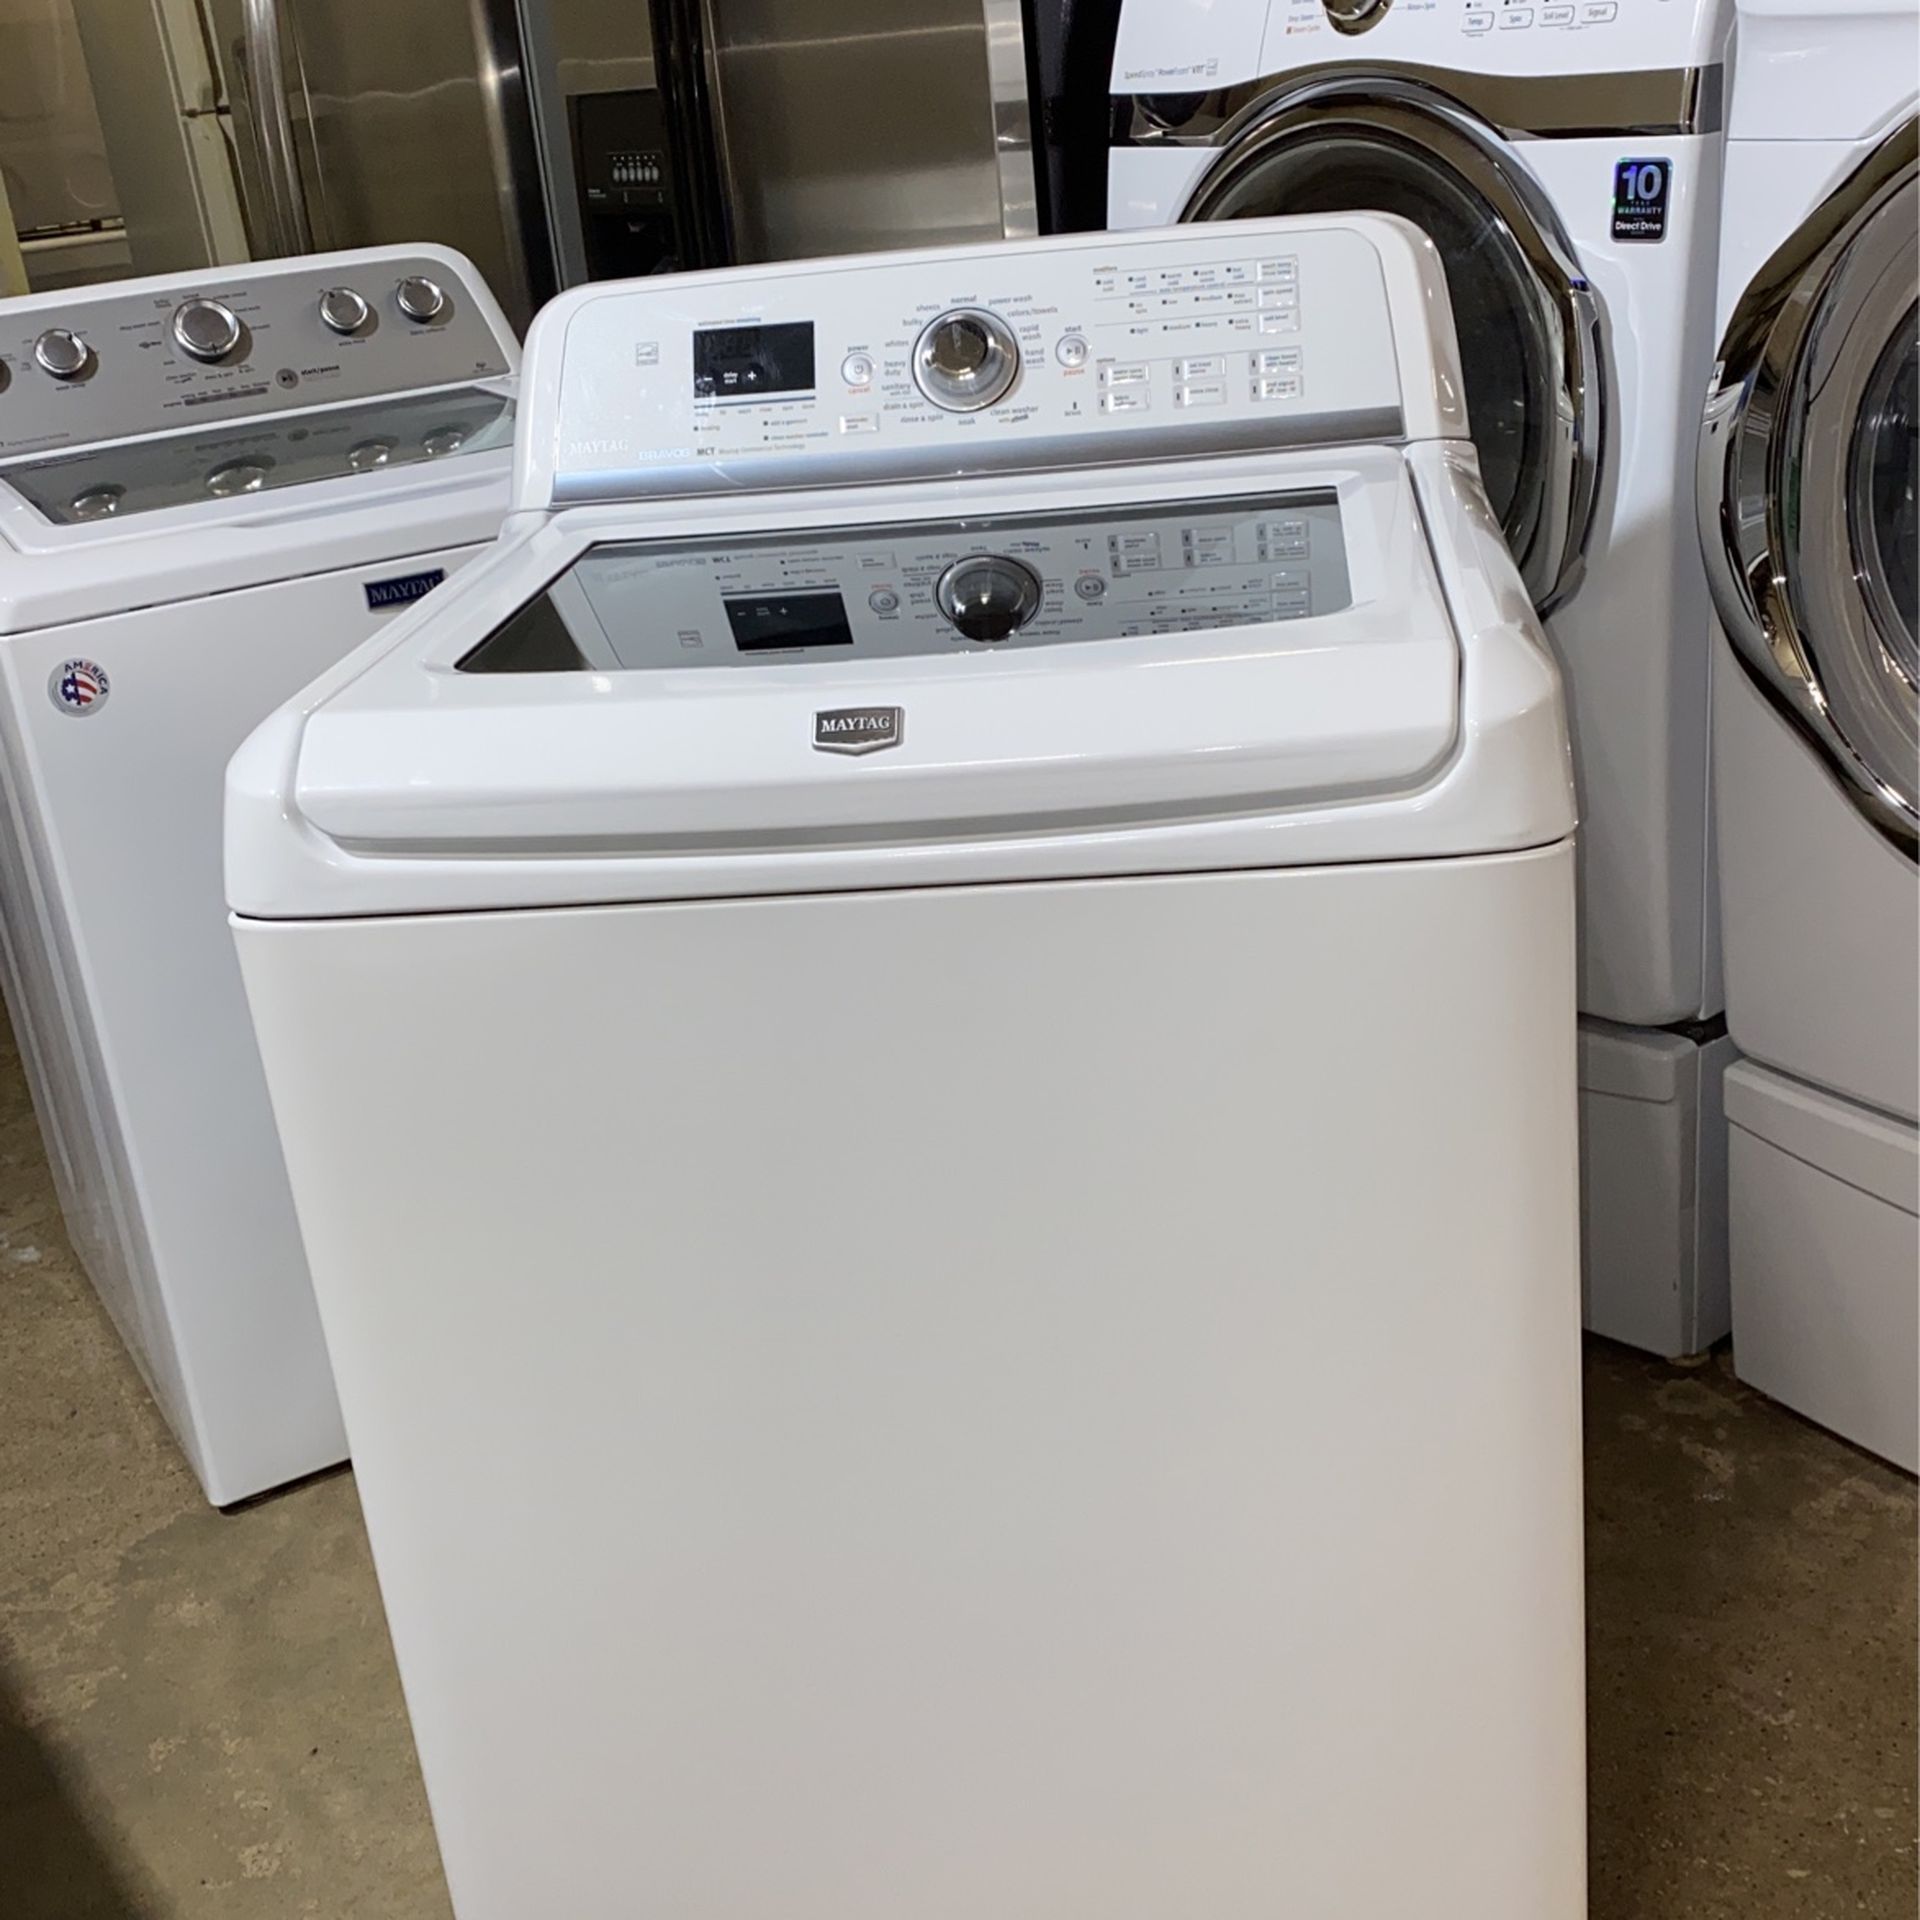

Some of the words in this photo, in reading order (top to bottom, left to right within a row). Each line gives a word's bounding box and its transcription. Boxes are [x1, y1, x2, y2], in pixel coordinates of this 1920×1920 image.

[1622, 164, 1662, 201] 10
[1617, 206, 1663, 215] WARRANTY
[1615, 221, 1640, 231] Direct
[1641, 221, 1662, 231] Drive
[847, 345, 869, 353] power
[301, 364, 340, 375] start/pause
[568, 439, 629, 456] MAYTAG
[697, 446, 716, 456] MCT
[64, 660, 109, 696] AMERICA
[821, 716, 890, 733] MAYTAG
